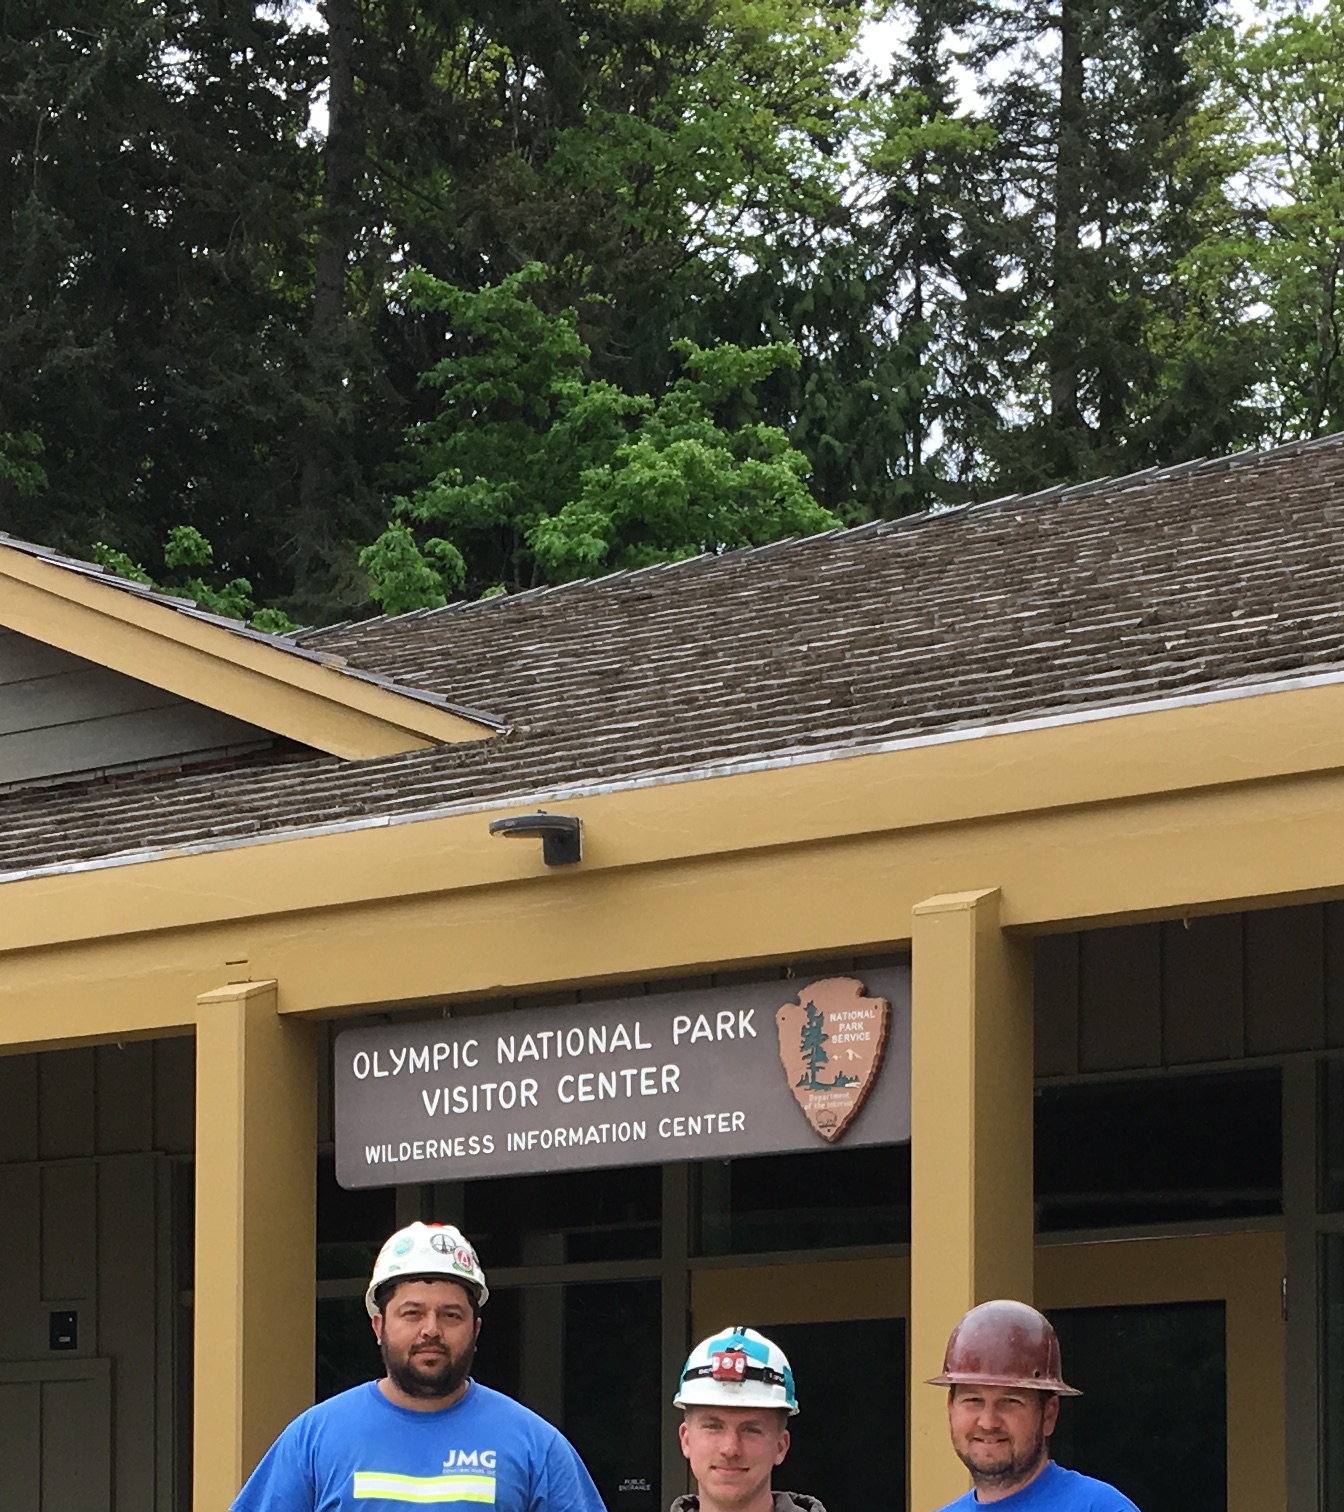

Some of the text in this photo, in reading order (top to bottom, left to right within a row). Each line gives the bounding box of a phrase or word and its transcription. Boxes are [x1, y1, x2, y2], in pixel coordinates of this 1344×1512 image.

[829, 1009, 876, 1022] NATIONAL
[839, 1021, 864, 1031] PARK
[354, 1009, 756, 1079] OLYMPIC NATIONAL PARK
[831, 1032, 871, 1044] SERVICE
[422, 1065, 680, 1116] VISITOR CENTER
[366, 1112, 745, 1164] WILDERNESS INFORMATION CENTER
[442, 1449, 497, 1469] JMG
